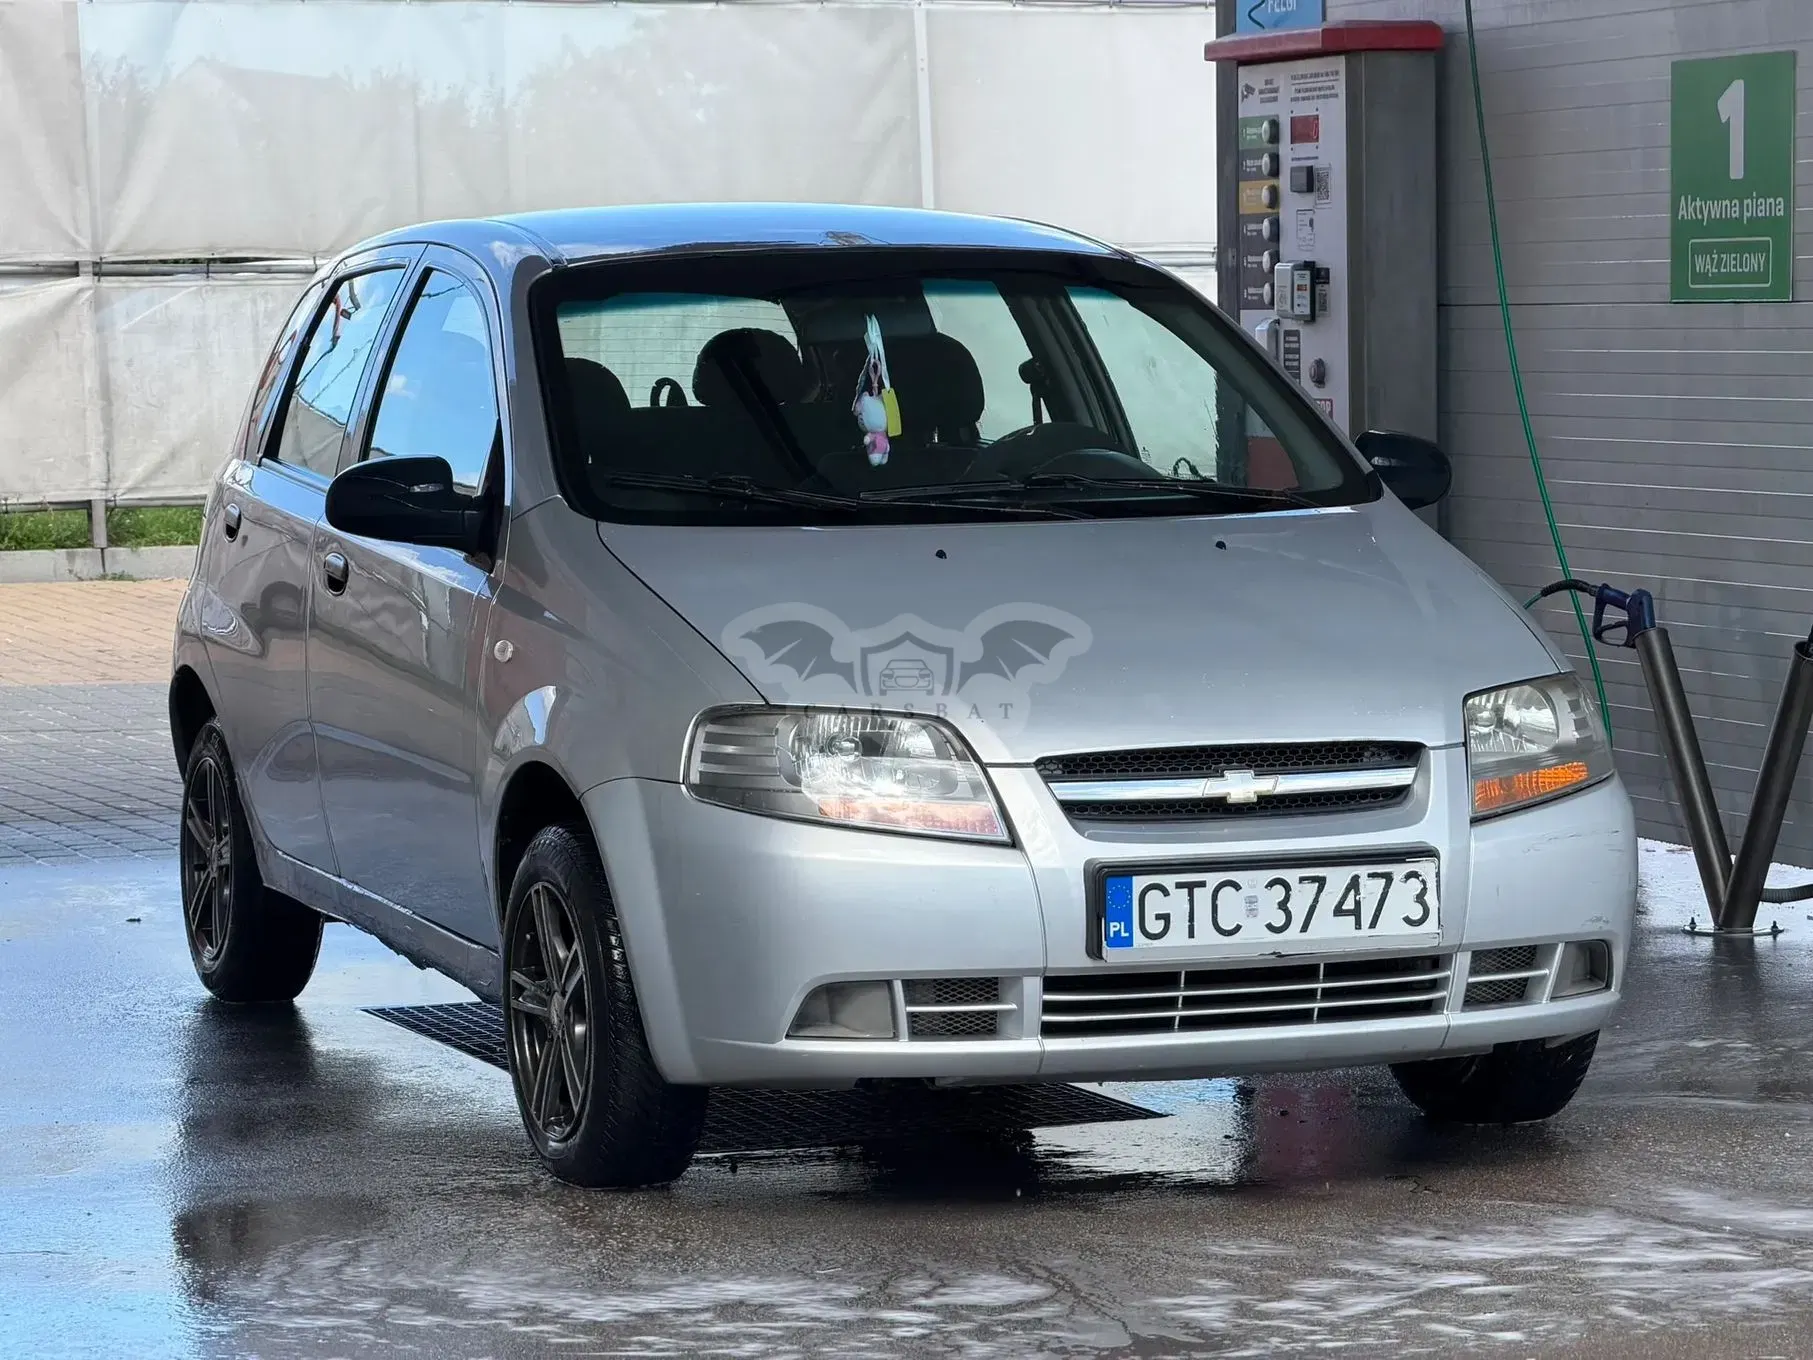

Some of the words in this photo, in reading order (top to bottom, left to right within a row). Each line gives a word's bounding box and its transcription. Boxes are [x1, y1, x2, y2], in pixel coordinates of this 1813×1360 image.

[1717, 79, 1745, 180] 1
[1678, 195, 1740, 226] Aktywna
[1743, 191, 1784, 224] piana
[1694, 249, 1718, 277] WĄŻ
[1720, 252, 1766, 273] ZIELONY
[1109, 921, 1130, 938] PL
[1138, 878, 1243, 941] GTC
[1264, 870, 1431, 935] 37473
